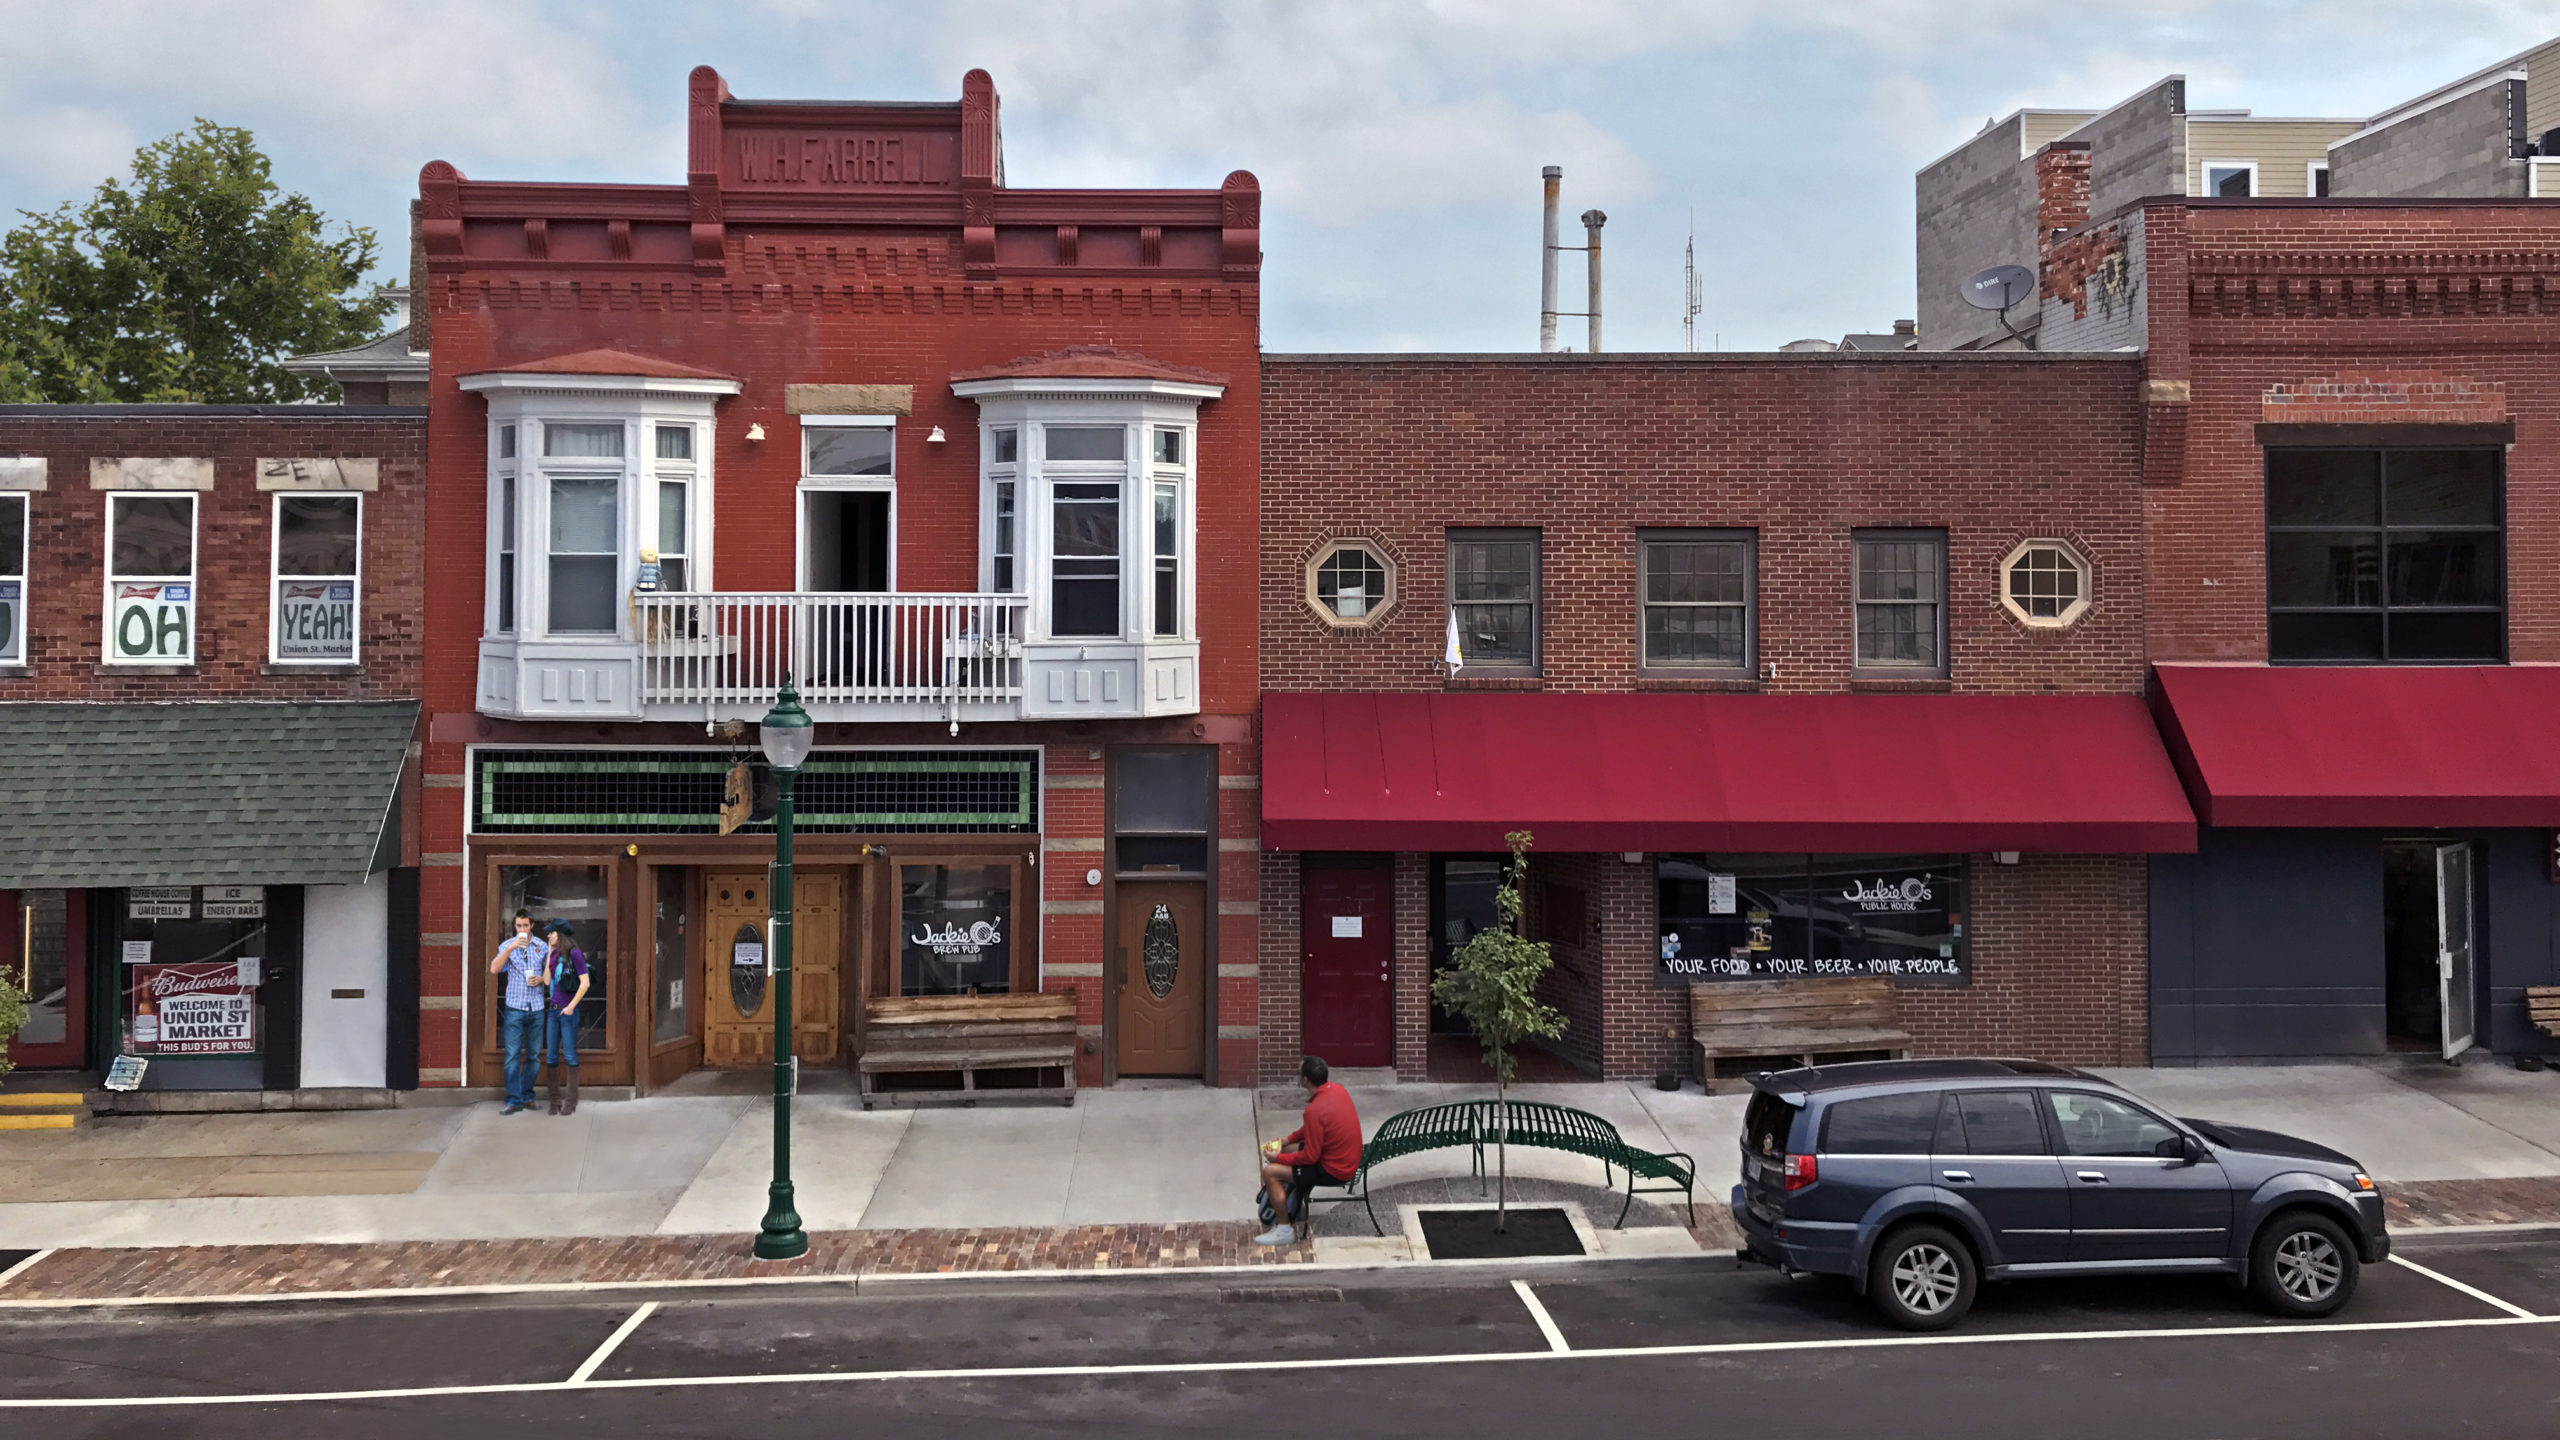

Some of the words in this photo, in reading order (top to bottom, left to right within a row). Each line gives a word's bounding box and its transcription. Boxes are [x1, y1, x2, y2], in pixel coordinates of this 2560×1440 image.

[283, 603, 354, 640] YEAH!
[119, 604, 188, 656] OH
[282, 645, 309, 653] Union
[225, 889, 240, 898] ICE
[138, 906, 183, 915] UMBRELLAS
[206, 906, 236, 915] ENERGY
[238, 906, 259, 915] BARS
[1155, 904, 1168, 913] 24
[1860, 902, 1889, 911] PUBLIC
[1891, 901, 1917, 911] HOUSE
[911, 921, 971, 946] Jackie
[933, 945, 960, 955] BREW
[962, 945, 981, 954] PUB
[1666, 958, 1707, 974] YOUR
[1711, 958, 1750, 973] FOOD
[1767, 958, 1808, 974] YOUR
[1814, 958, 1854, 974] BEER
[152, 973, 238, 996] Budweise
[169, 1000, 225, 1010] WELCOME
[229, 1000, 242, 1009] TO
[163, 1011, 222, 1024] UNION
[227, 1010, 250, 1023] ST
[168, 1024, 244, 1039] MARKET
[158, 1043, 179, 1052] THIS
[181, 1042, 209, 1051] BUD'S
[211, 1042, 229, 1050] FOR
[232, 1041, 253, 1050] YOU.
